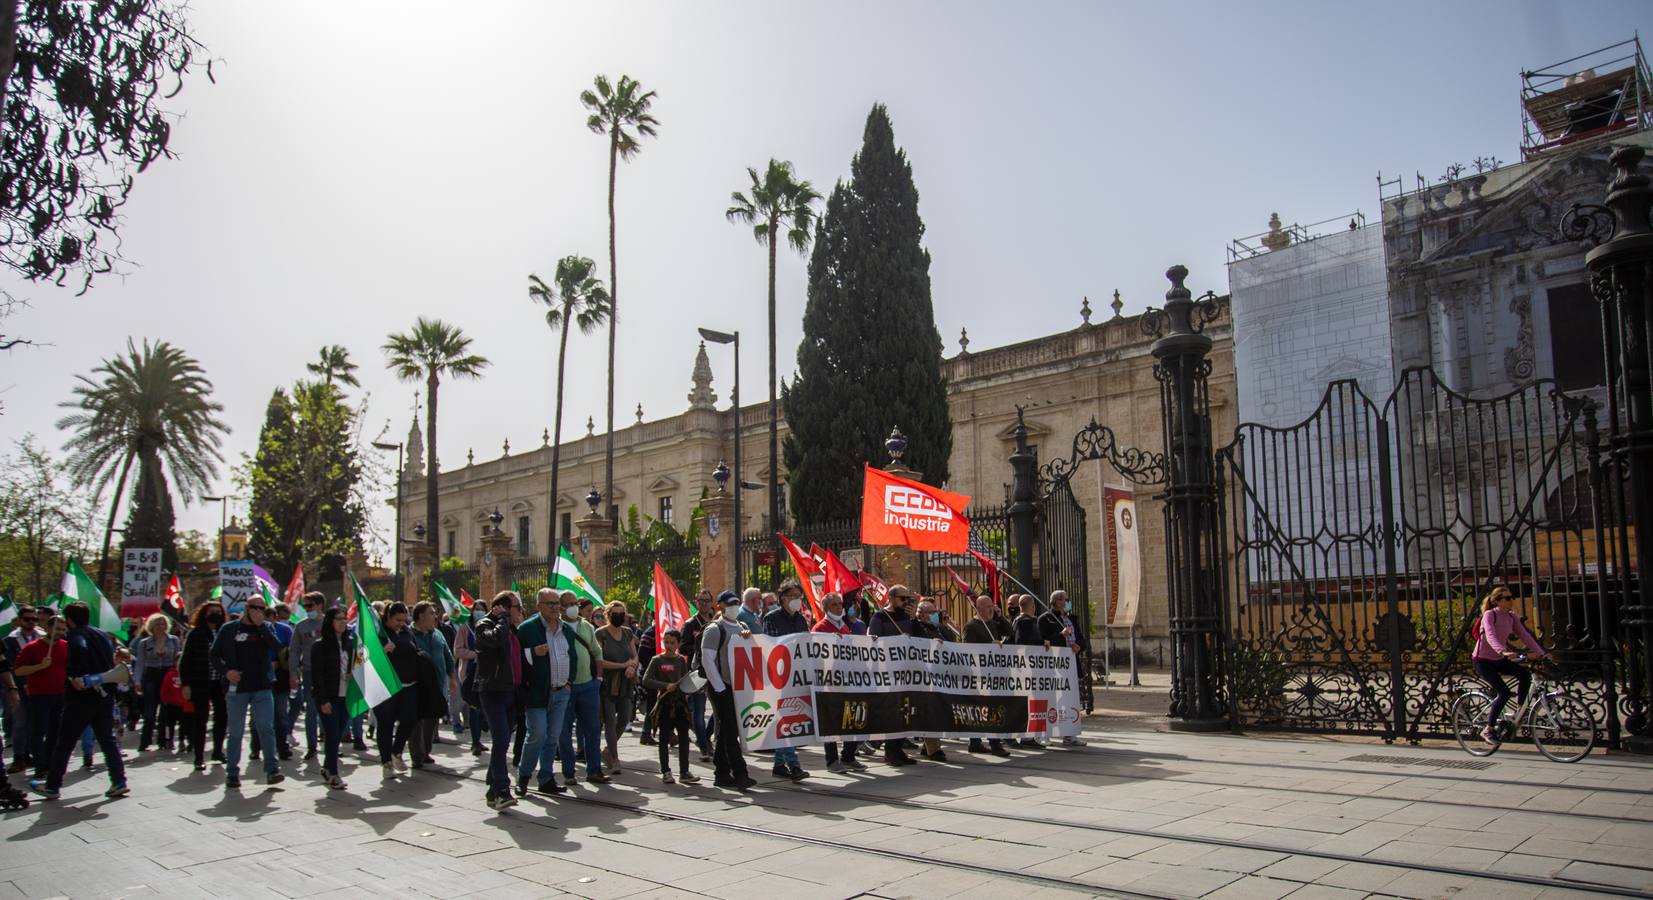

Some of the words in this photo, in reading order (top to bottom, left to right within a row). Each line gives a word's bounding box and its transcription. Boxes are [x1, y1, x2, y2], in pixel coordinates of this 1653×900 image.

[889, 491, 948, 513] CCOO
[884, 509, 950, 533] industria
[134, 573, 148, 582] EN
[793, 643, 803, 660] A
[807, 642, 830, 659] LOS
[833, 643, 886, 662] DESPIDOS
[890, 646, 906, 661] EN
[942, 651, 976, 667] SANTA
[979, 651, 1022, 669] BÁRBARA
[1029, 655, 1070, 670] SISTEMAS
[734, 644, 791, 691] NO
[792, 669, 812, 687] AL
[815, 668, 871, 687] TRASLADO
[874, 672, 891, 686] DE
[894, 669, 958, 690] PRODUCCIÓN
[961, 675, 977, 690] DE
[980, 673, 1023, 690] FÁBRICA
[1025, 677, 1037, 690] DE
[1039, 677, 1071, 691] SEVILLA
[742, 714, 774, 728] CSIF
[780, 721, 811, 737] CGT
